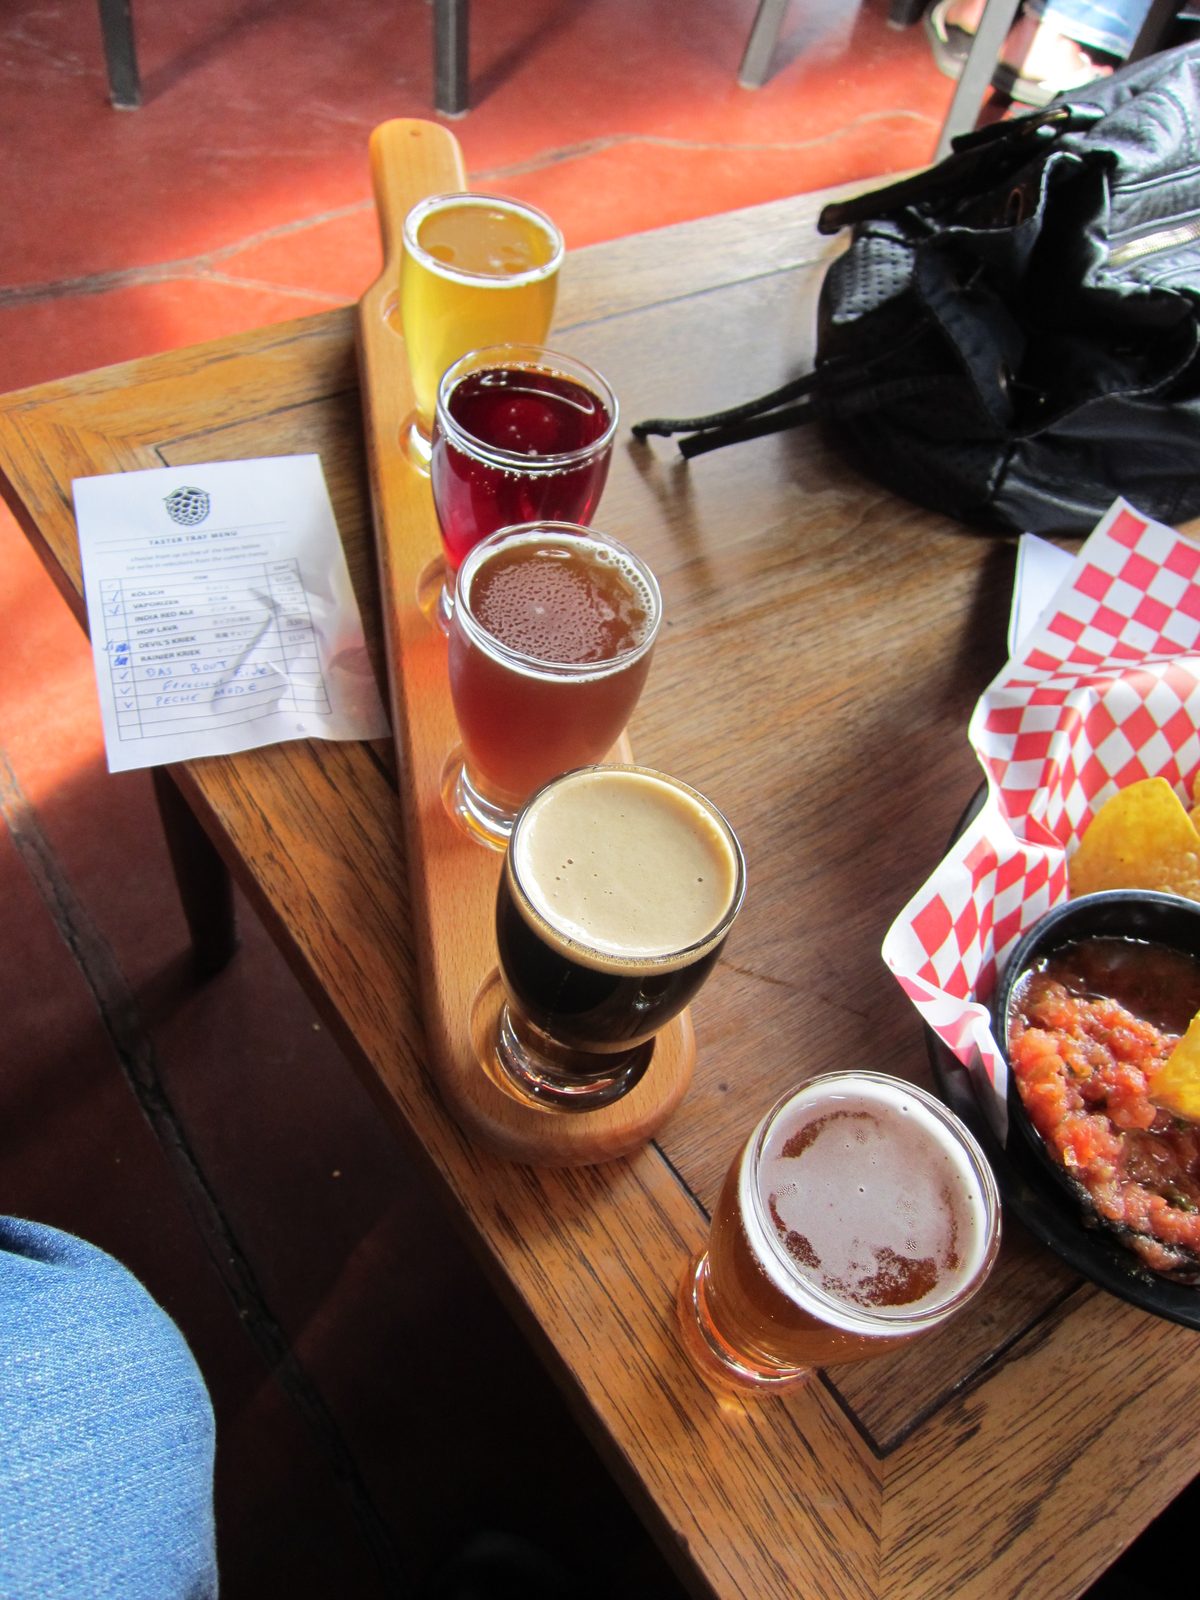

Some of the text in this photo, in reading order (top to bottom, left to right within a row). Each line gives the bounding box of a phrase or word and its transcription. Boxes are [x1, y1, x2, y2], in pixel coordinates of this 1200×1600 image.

[149, 531, 238, 546] TASTER TRAY MENU
[134, 614, 159, 622] INDIA
[160, 611, 177, 619] RED
[157, 625, 178, 633] LAVA
[138, 635, 197, 649] DEVIL'S KRIEK
[140, 649, 201, 662] RAINIER KRIEK
